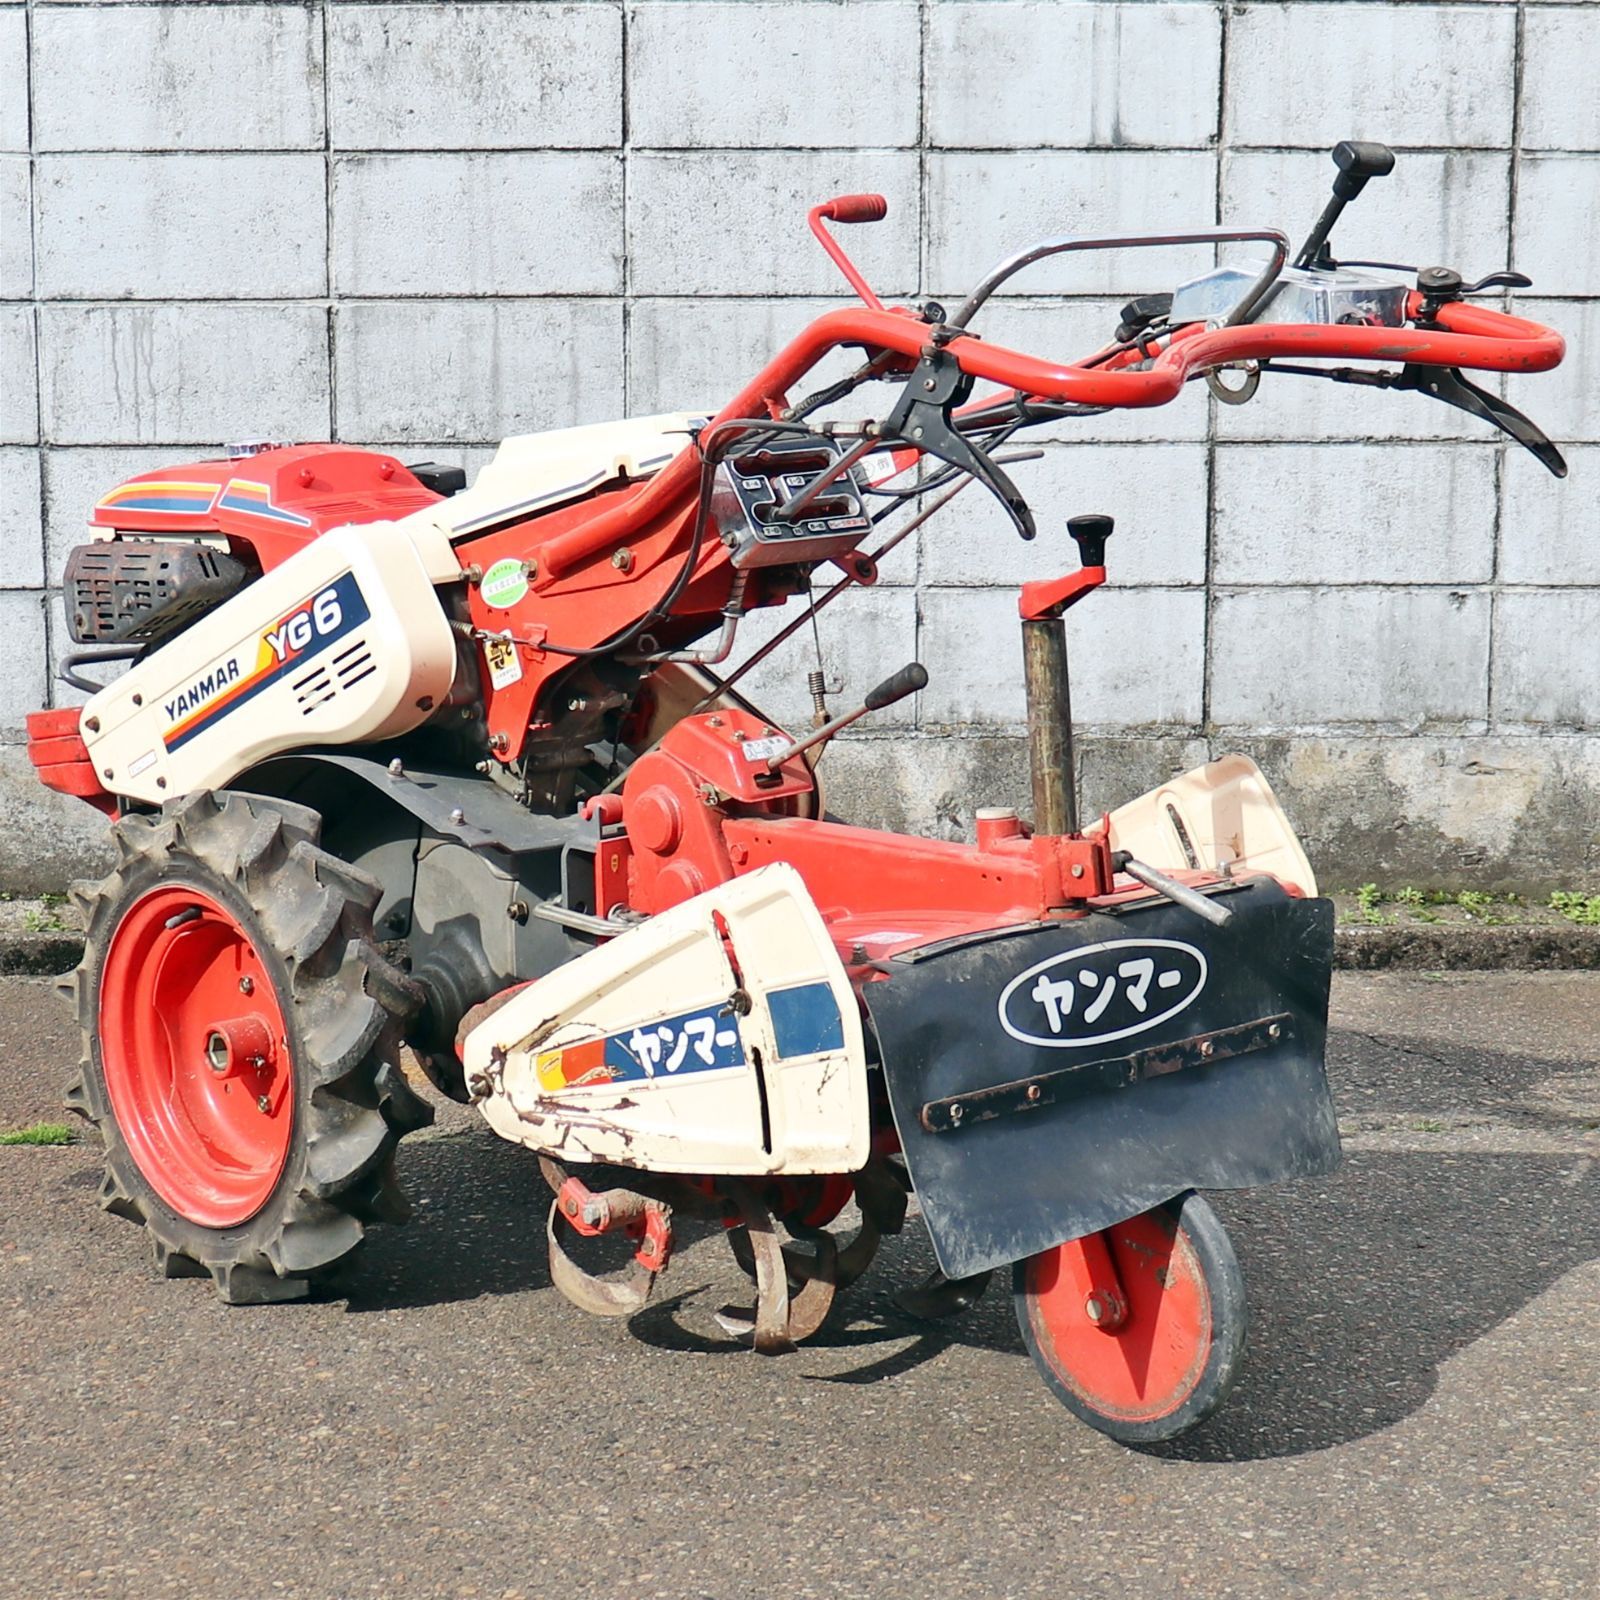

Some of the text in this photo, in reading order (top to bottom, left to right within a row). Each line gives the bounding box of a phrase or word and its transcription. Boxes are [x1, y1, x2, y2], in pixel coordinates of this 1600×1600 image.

[165, 588, 343, 721] YANMAR YG6
[1031, 957, 1181, 1034] ヤンマー
[630, 1016, 737, 1073] ヤンマー
